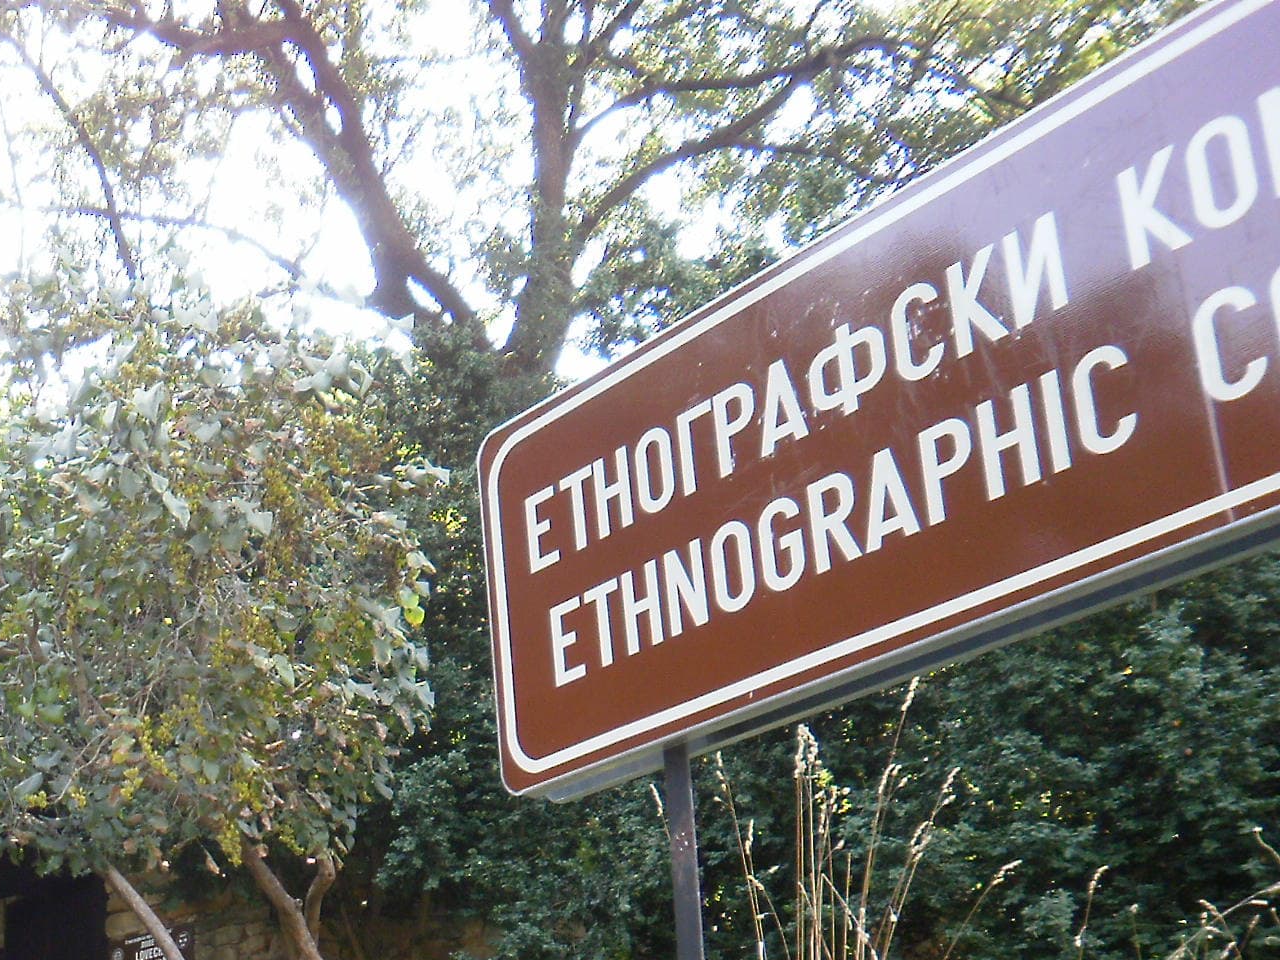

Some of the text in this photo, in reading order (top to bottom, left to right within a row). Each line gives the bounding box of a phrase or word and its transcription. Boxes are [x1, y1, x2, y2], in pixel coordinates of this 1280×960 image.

[525, 211, 1068, 574] ЕТНОГРАФСКИ
[549, 264, 1280, 688] ETHNOGRAPHIC C
